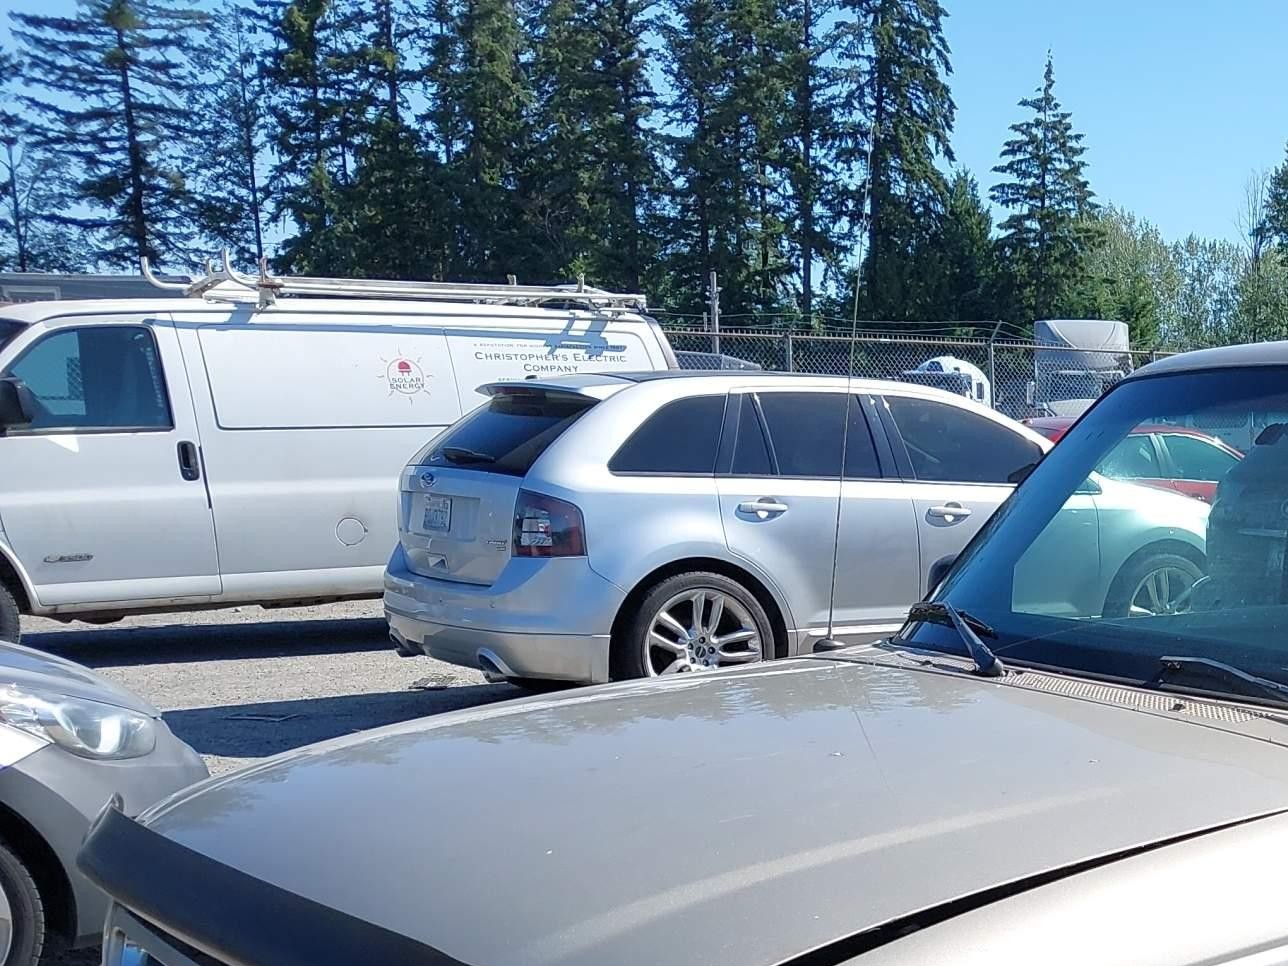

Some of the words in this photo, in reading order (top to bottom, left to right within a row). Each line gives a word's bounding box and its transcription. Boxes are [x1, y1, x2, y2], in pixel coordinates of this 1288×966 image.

[474, 351, 568, 362] CHRISTOPHER'S
[574, 353, 627, 363] ELECTRIC
[523, 363, 578, 373] COMPANY
